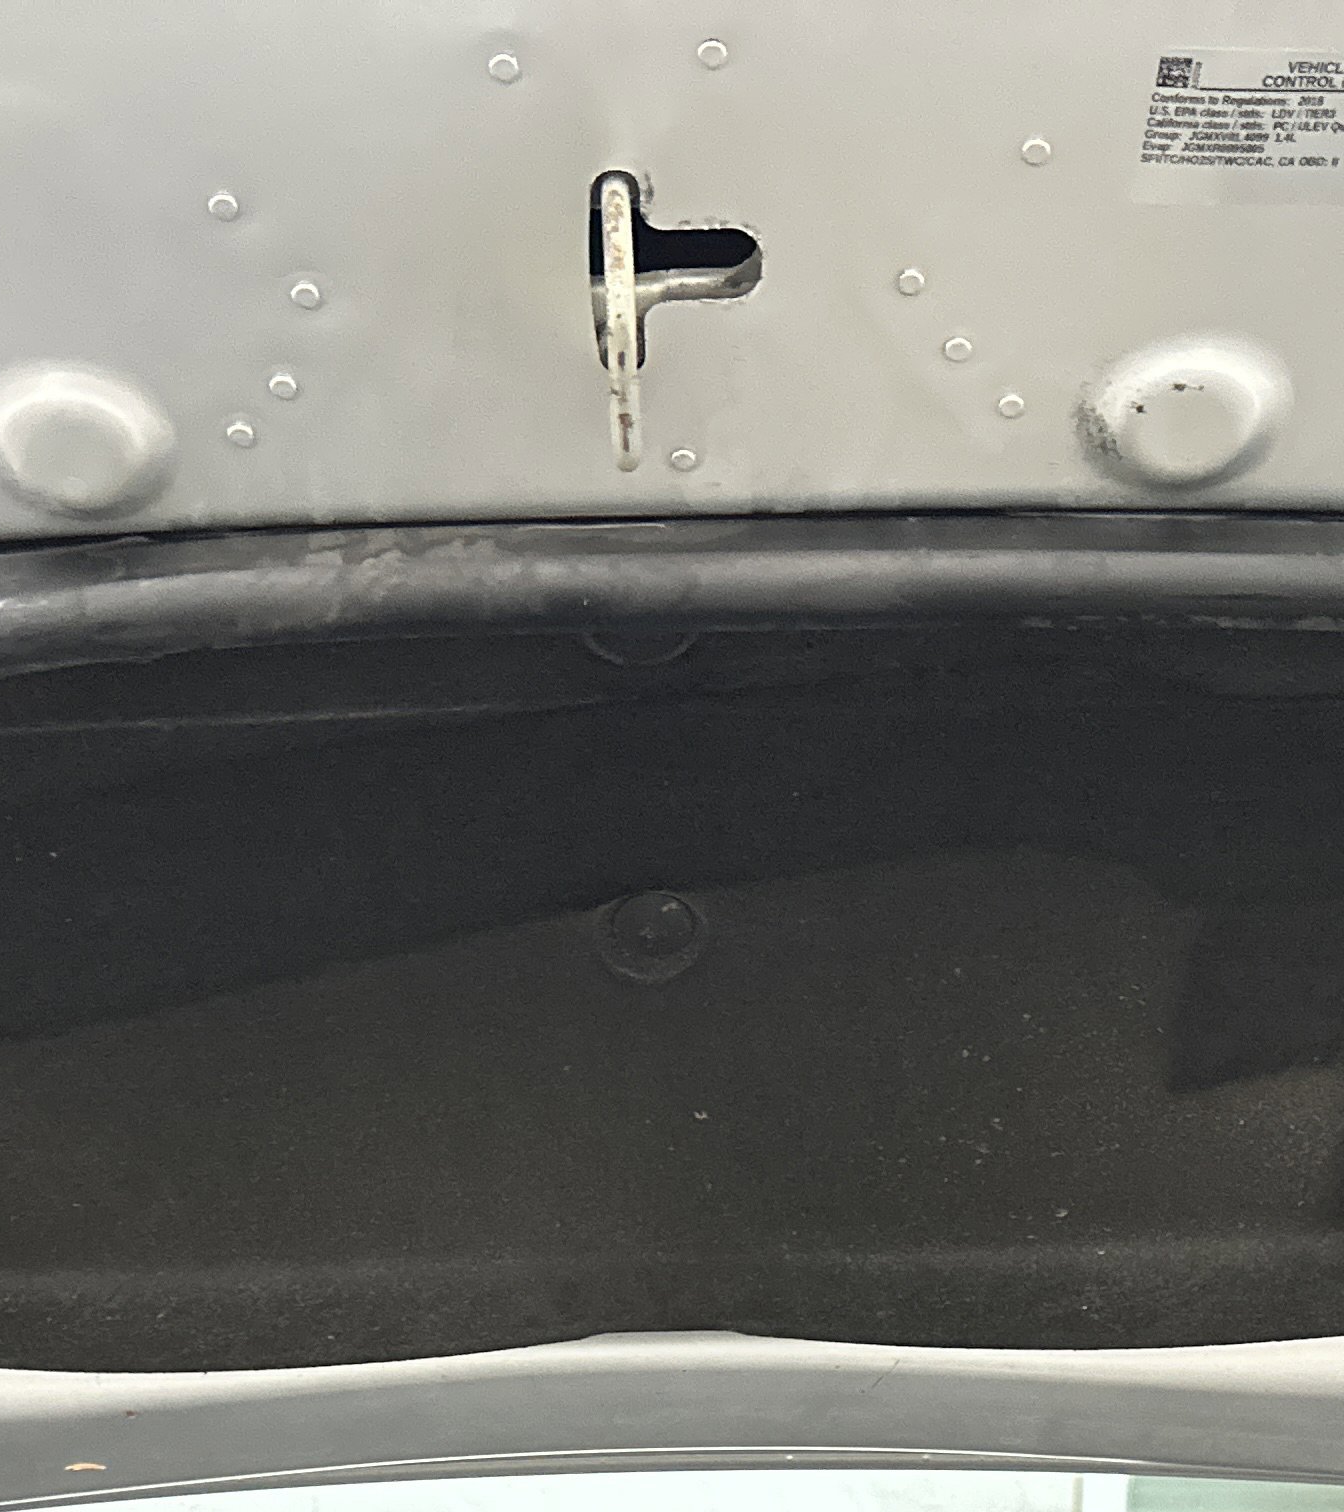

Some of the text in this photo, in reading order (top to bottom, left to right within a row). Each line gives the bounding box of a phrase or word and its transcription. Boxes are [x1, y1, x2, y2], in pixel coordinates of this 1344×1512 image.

[1262, 75, 1337, 88] CONTROL
[1151, 92, 1206, 104] Conforms
[1174, 106, 1197, 117] EPA
